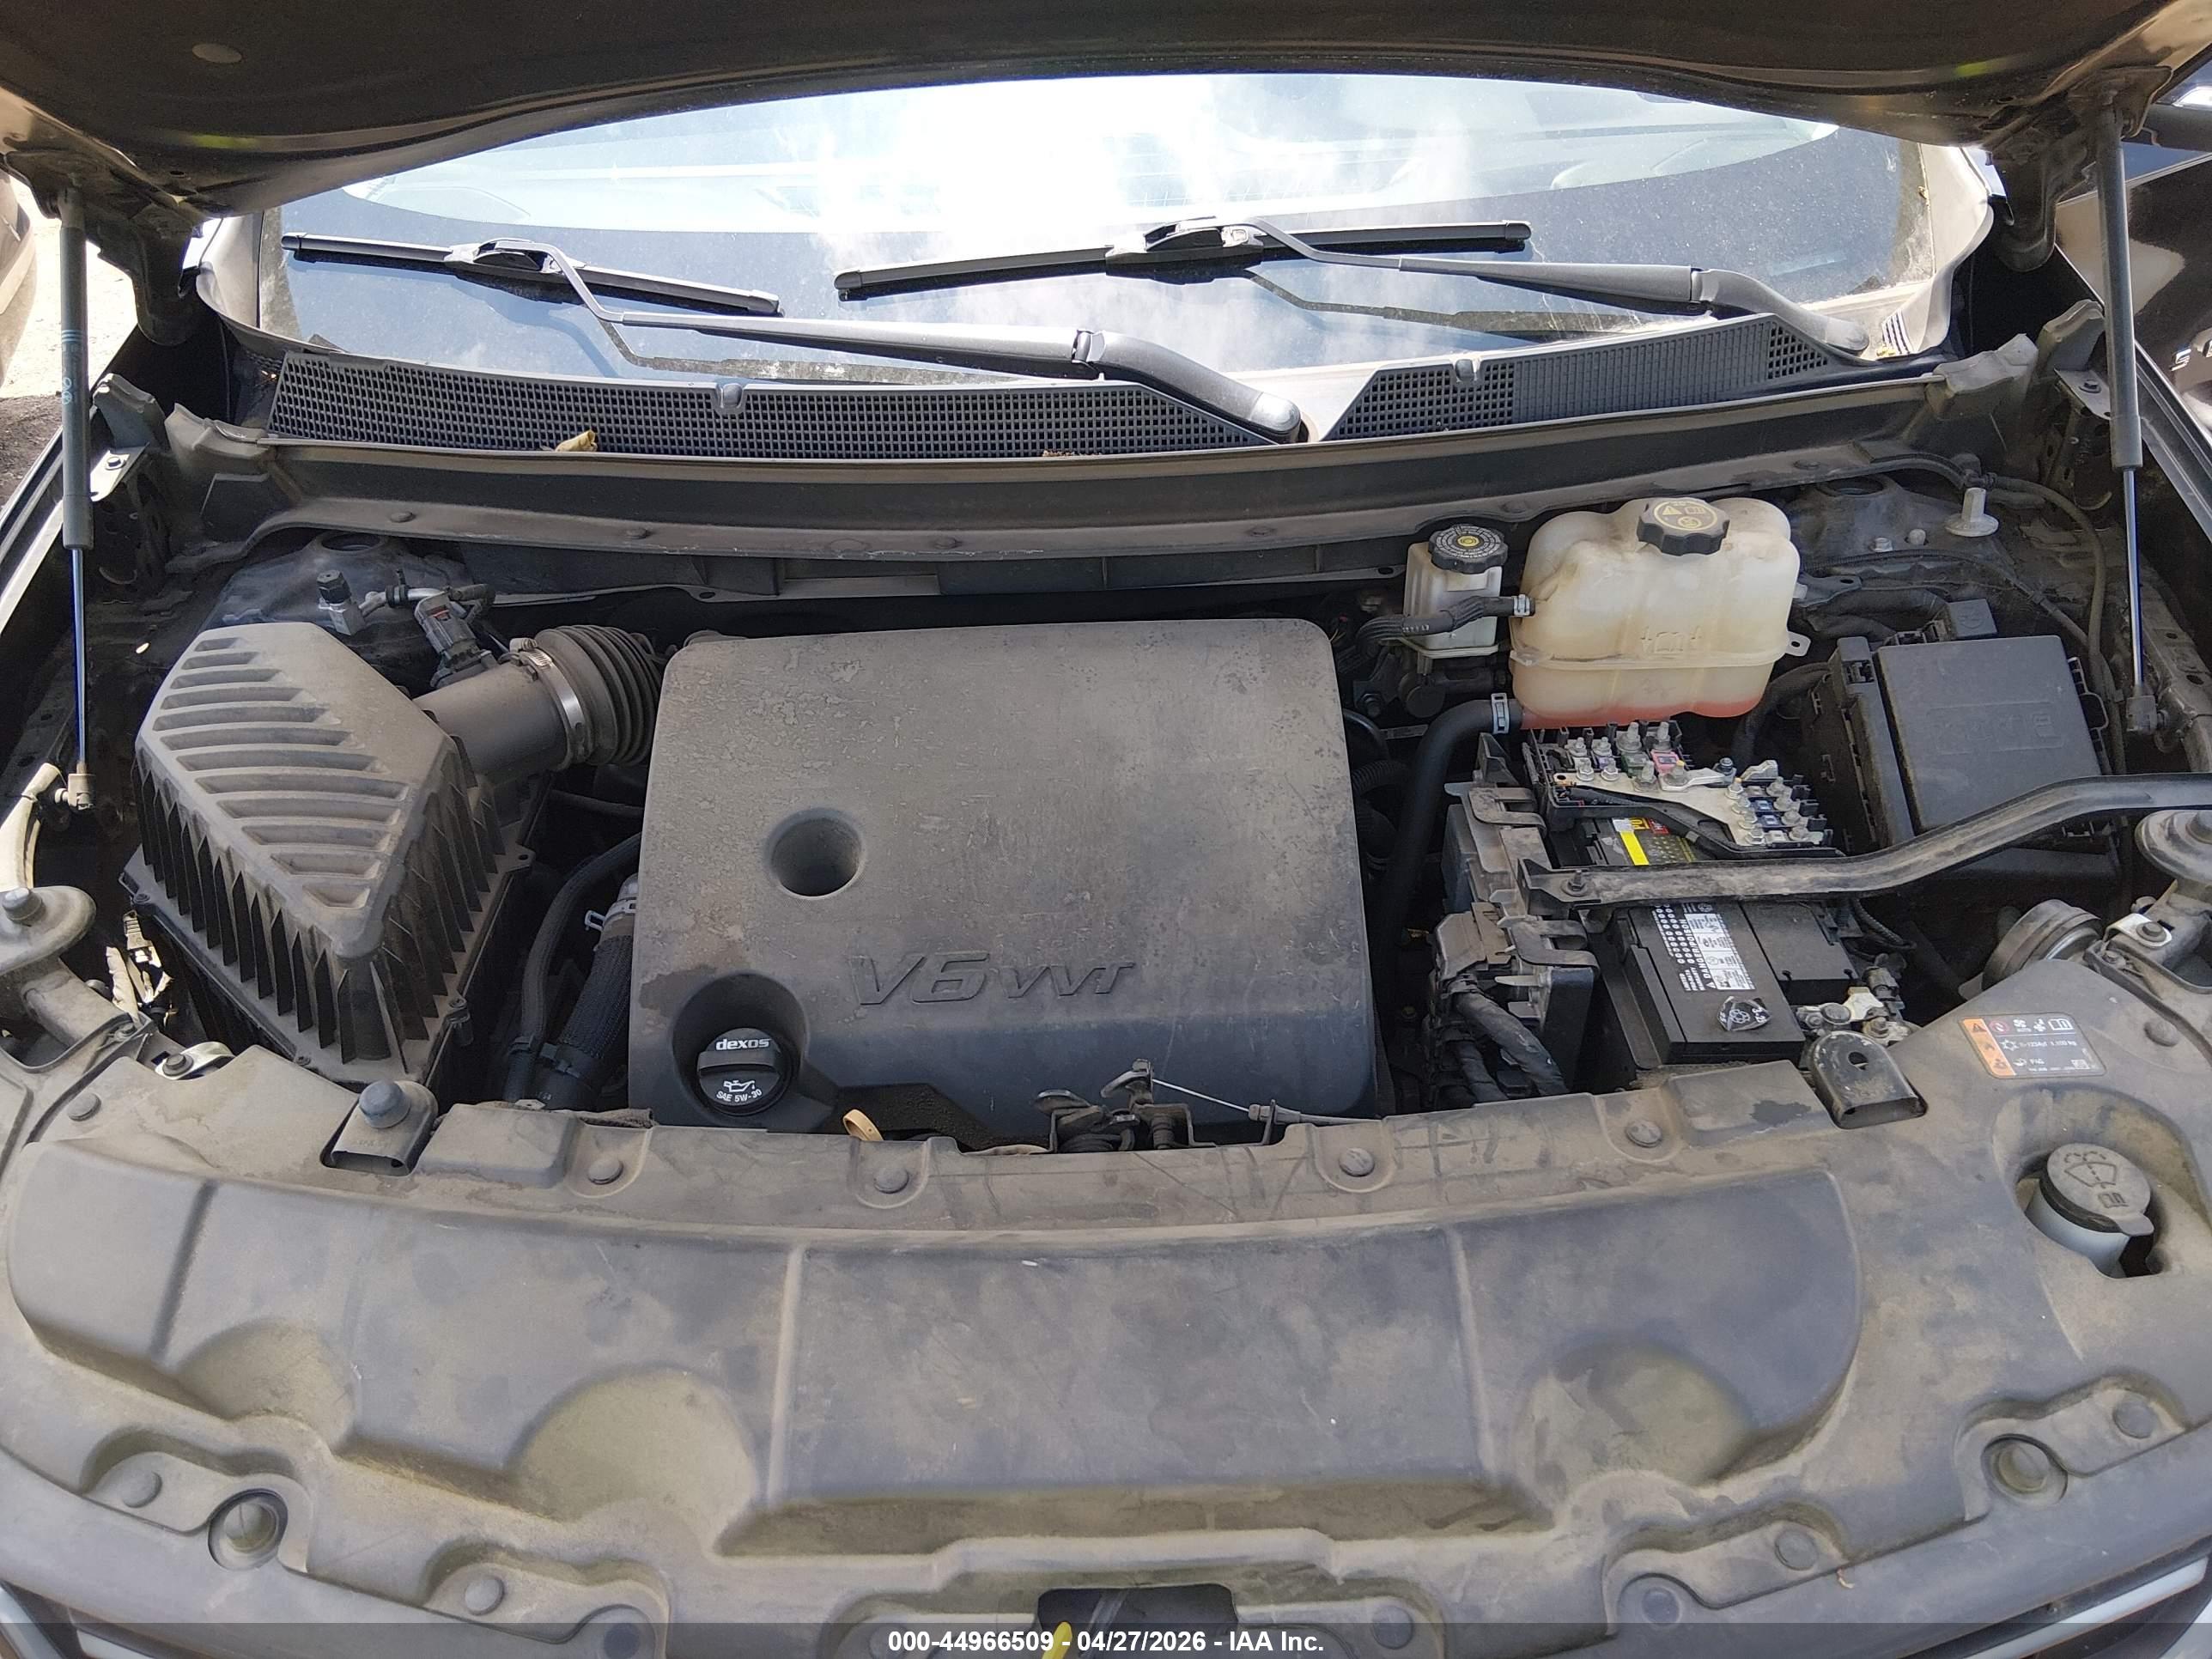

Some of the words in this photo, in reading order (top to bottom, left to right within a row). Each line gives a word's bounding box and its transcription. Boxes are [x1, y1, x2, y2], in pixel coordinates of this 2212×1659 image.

[852, 951, 989, 1006] V6
[998, 961, 1134, 999] VVT
[715, 1038, 772, 1051] dexos
[716, 1091, 732, 1102] SAE
[734, 1089, 763, 1103] 5W-30
